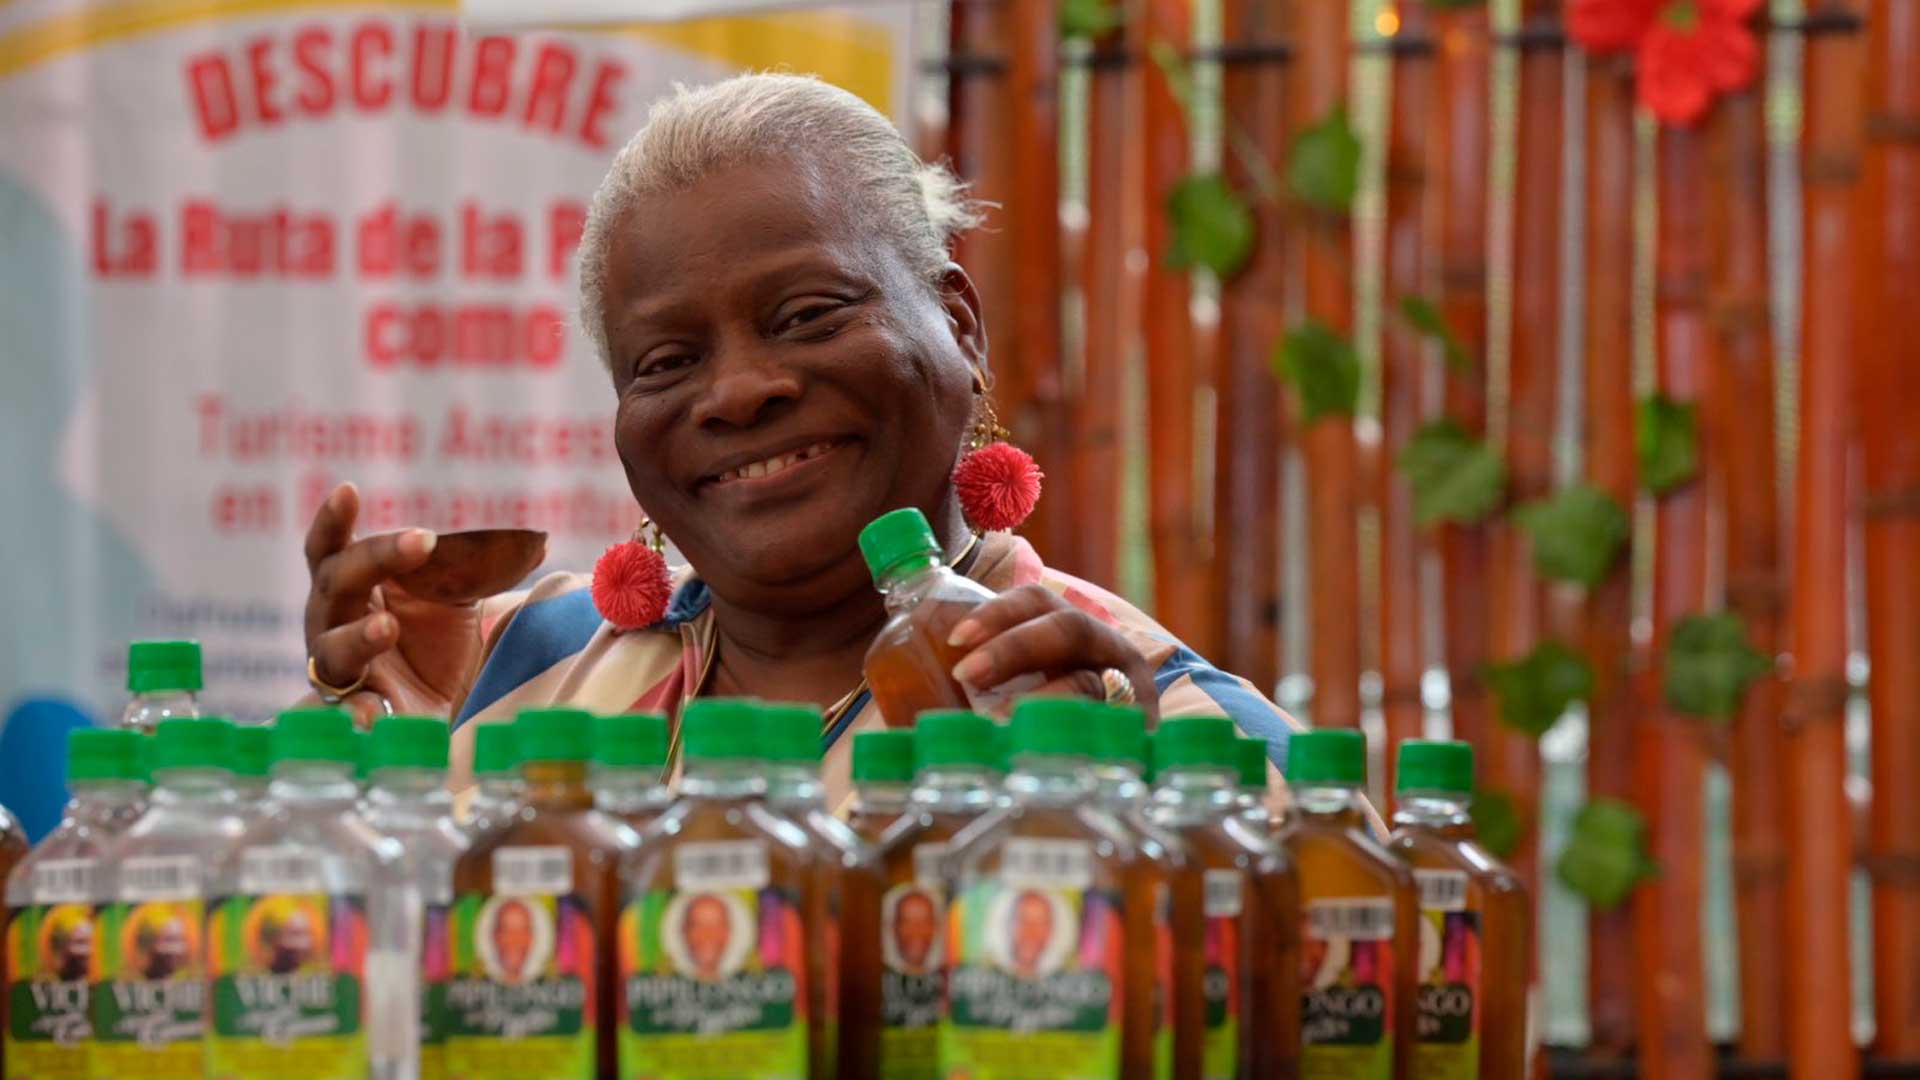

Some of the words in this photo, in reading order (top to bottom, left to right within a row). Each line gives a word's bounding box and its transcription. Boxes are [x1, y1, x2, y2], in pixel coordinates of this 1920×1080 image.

[187, 22, 628, 148] DESCUBRE
[93, 200, 157, 276] La
[182, 200, 334, 276] Ruta
[358, 202, 439, 278] de
[461, 201, 523, 277] la
[548, 202, 588, 278] P
[366, 303, 564, 367] como
[194, 393, 418, 461] Turismo
[438, 402, 617, 463] Ances
[212, 487, 278, 536] en
